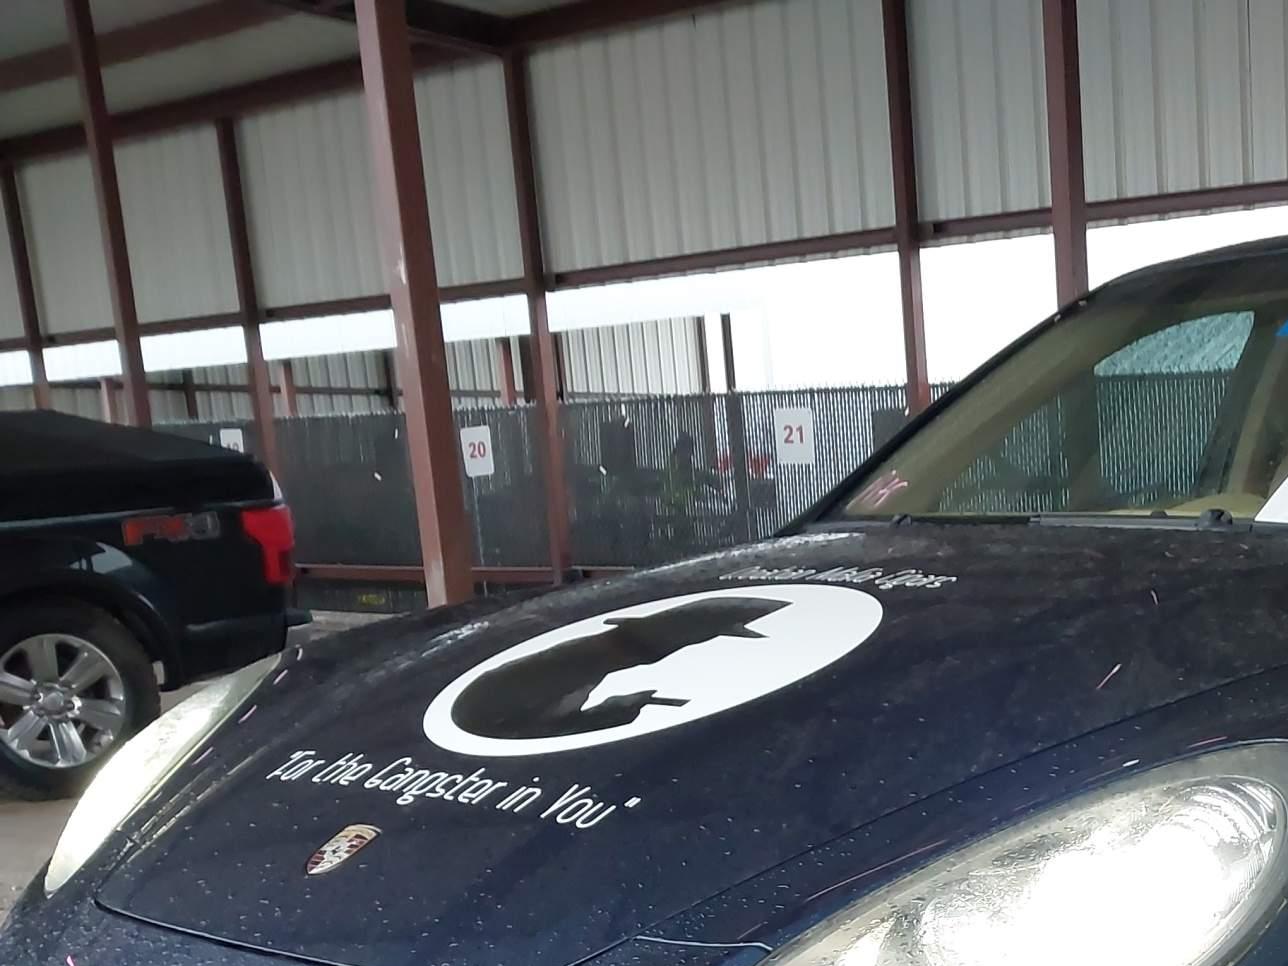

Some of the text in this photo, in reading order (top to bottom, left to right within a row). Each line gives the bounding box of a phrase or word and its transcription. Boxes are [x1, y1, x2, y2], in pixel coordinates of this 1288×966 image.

[783, 424, 805, 444] 21
[468, 441, 486, 459] 20
[311, 752, 365, 784] the
[363, 757, 509, 805] Gangster
[495, 776, 542, 814] in
